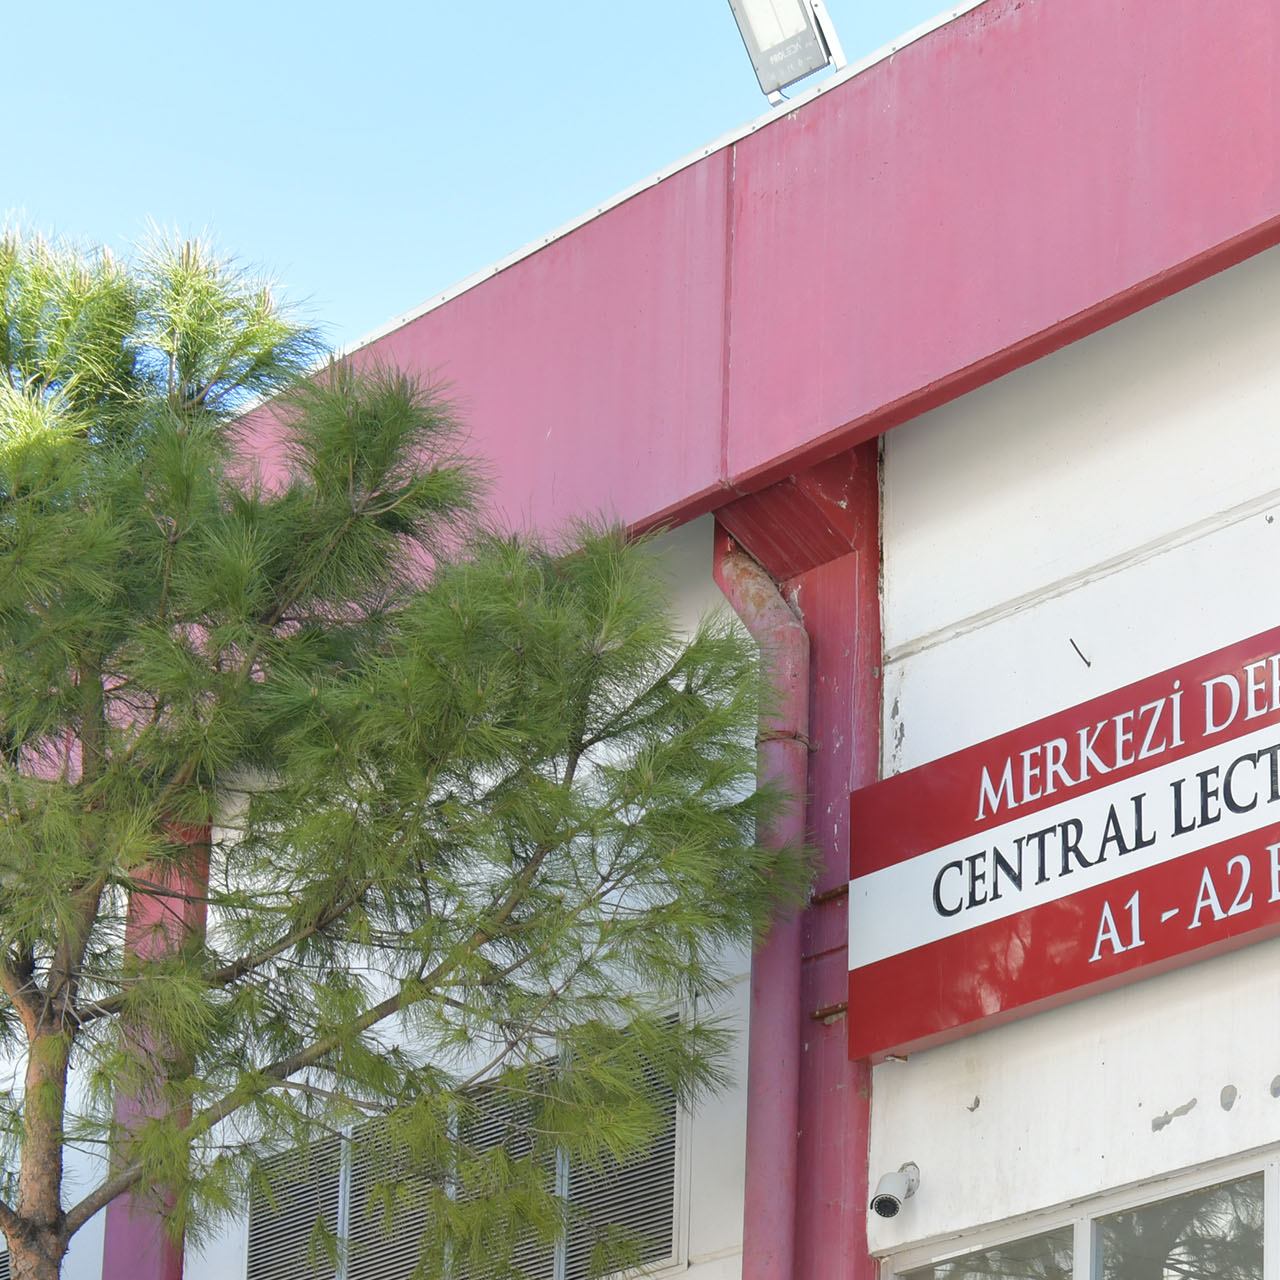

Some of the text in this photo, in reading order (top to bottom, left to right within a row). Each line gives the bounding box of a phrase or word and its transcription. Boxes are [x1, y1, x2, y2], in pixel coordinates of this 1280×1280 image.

[975, 679, 1185, 820] MERKEZİ
[932, 792, 1156, 917] CENTRAL
[1088, 890, 1145, 963] A1
[1161, 907, 1180, 923] -
[1187, 855, 1252, 929] A2
